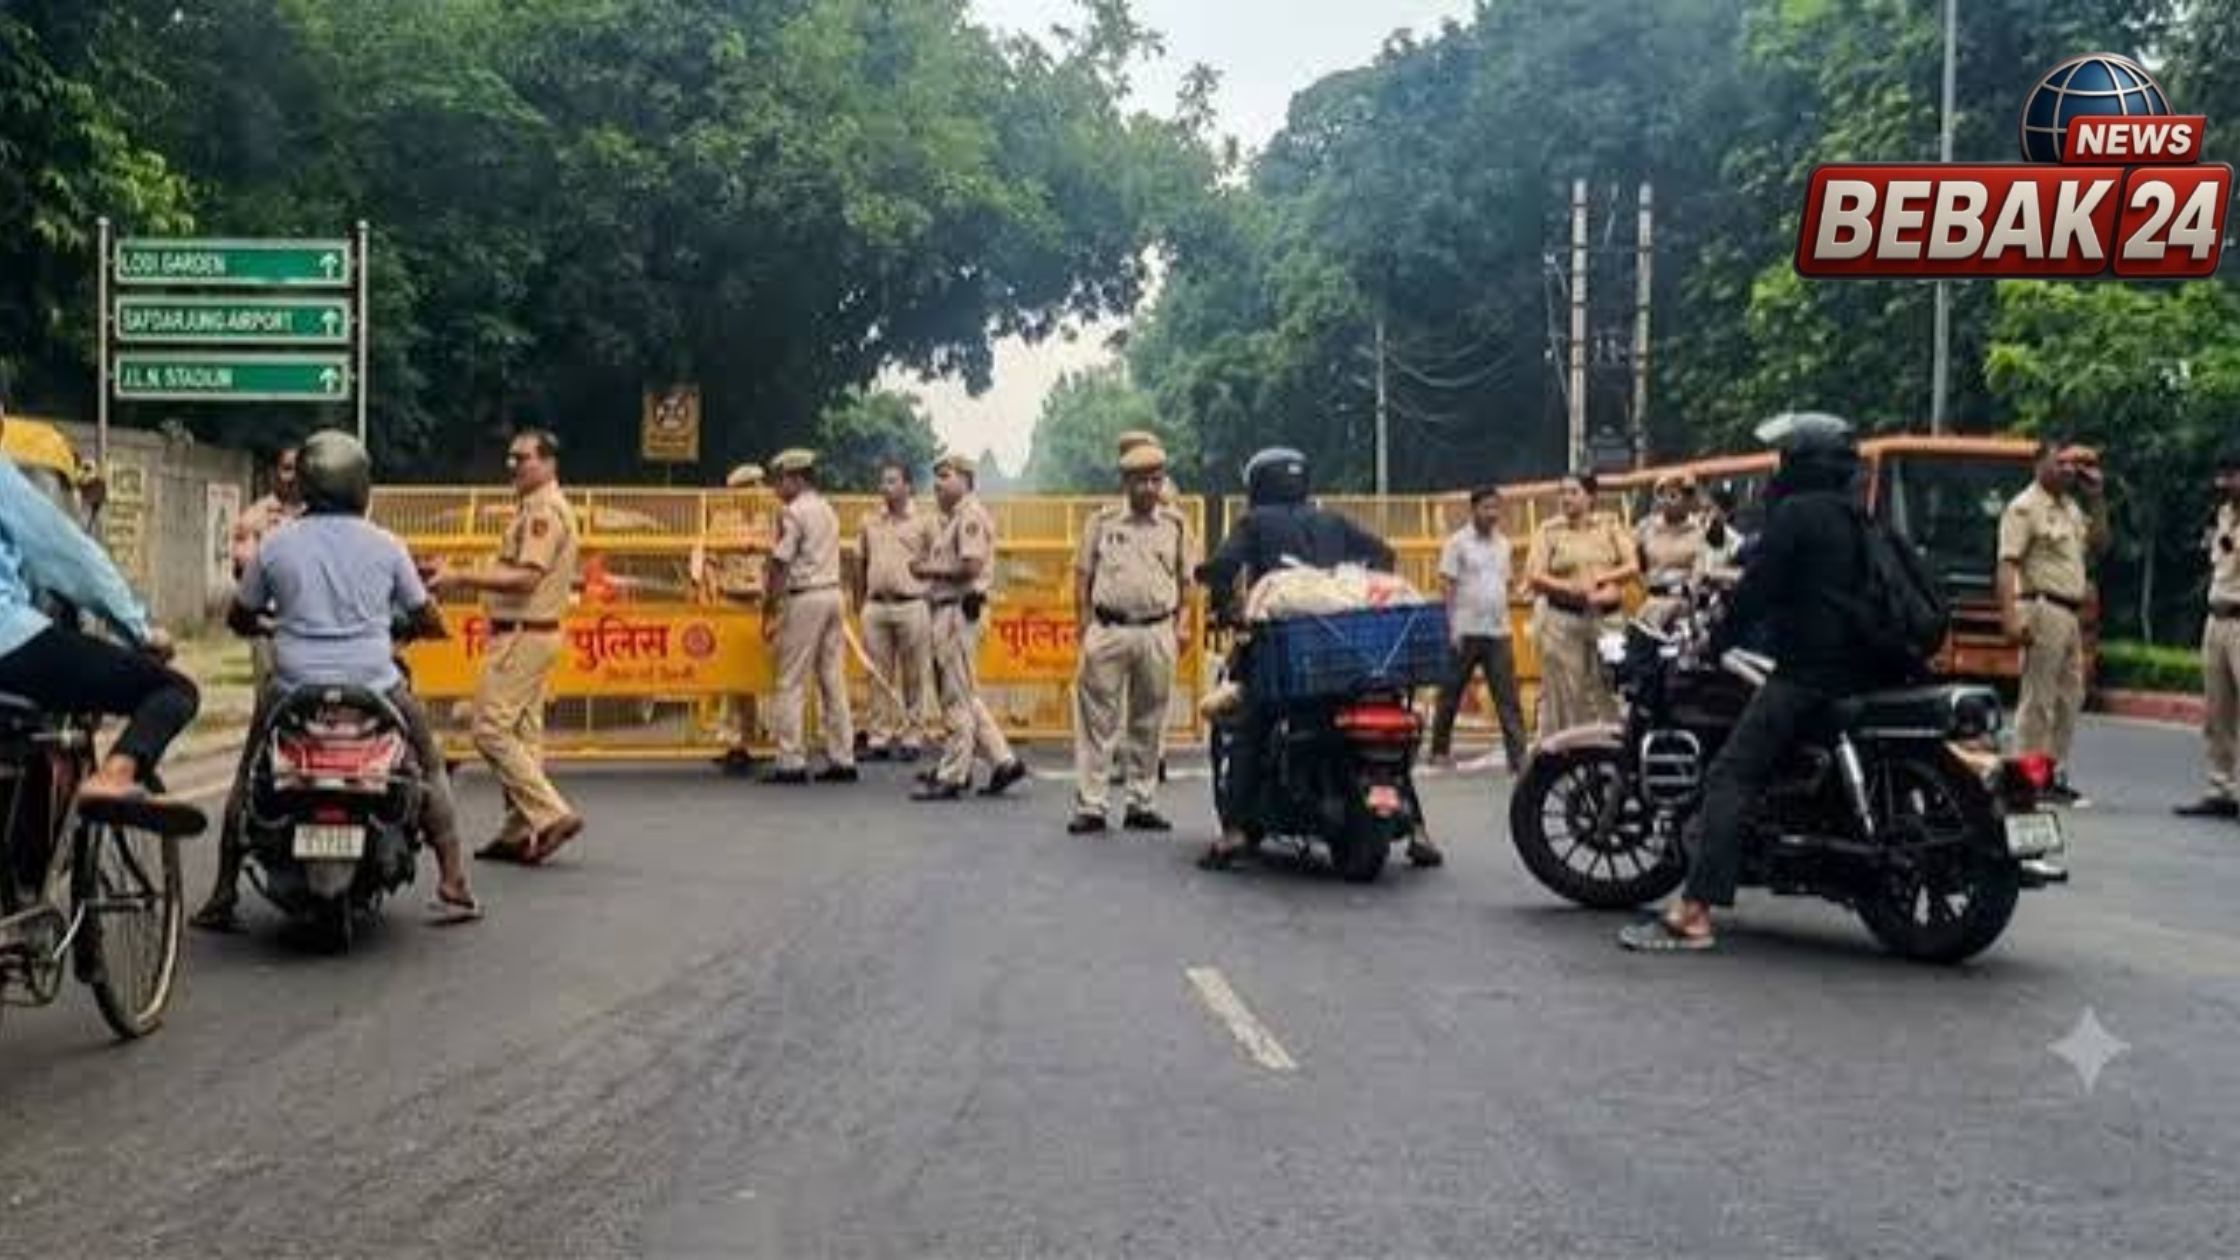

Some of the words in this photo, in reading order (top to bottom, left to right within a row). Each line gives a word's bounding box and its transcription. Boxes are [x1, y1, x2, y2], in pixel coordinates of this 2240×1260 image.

[162, 253, 226, 275] GARDEN
[227, 309, 293, 333] AIRPORT
[567, 613, 670, 672] पुलिस
